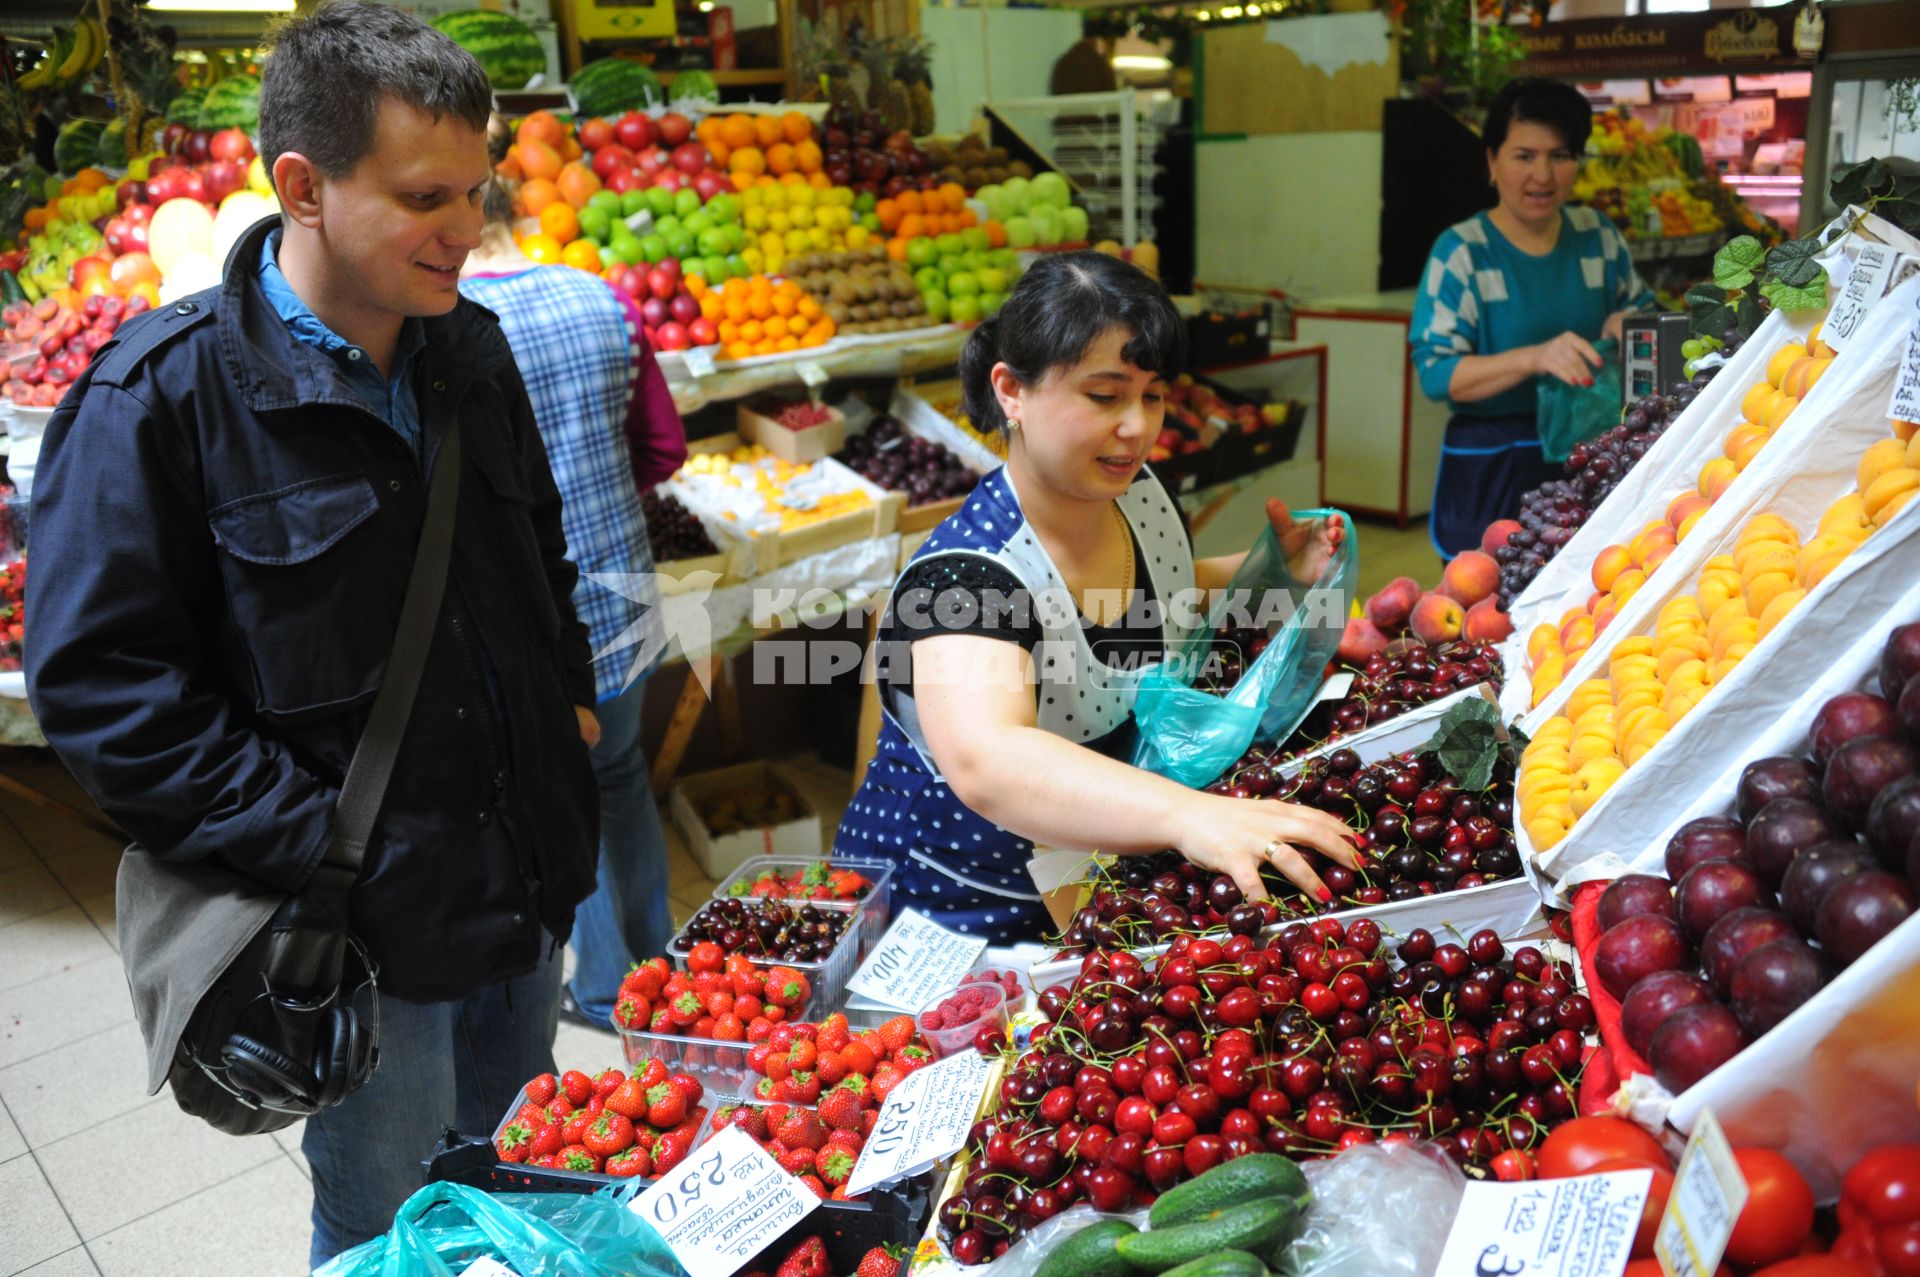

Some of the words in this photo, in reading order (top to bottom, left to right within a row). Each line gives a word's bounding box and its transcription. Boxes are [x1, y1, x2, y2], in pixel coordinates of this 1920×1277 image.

[1574, 25, 1666, 49] колбасы
[872, 944, 907, 979] 400
[873, 1102, 915, 1154] 250
[654, 1151, 737, 1222] 250
[734, 1156, 763, 1179] 1кг
[730, 1200, 803, 1256] Вишня
